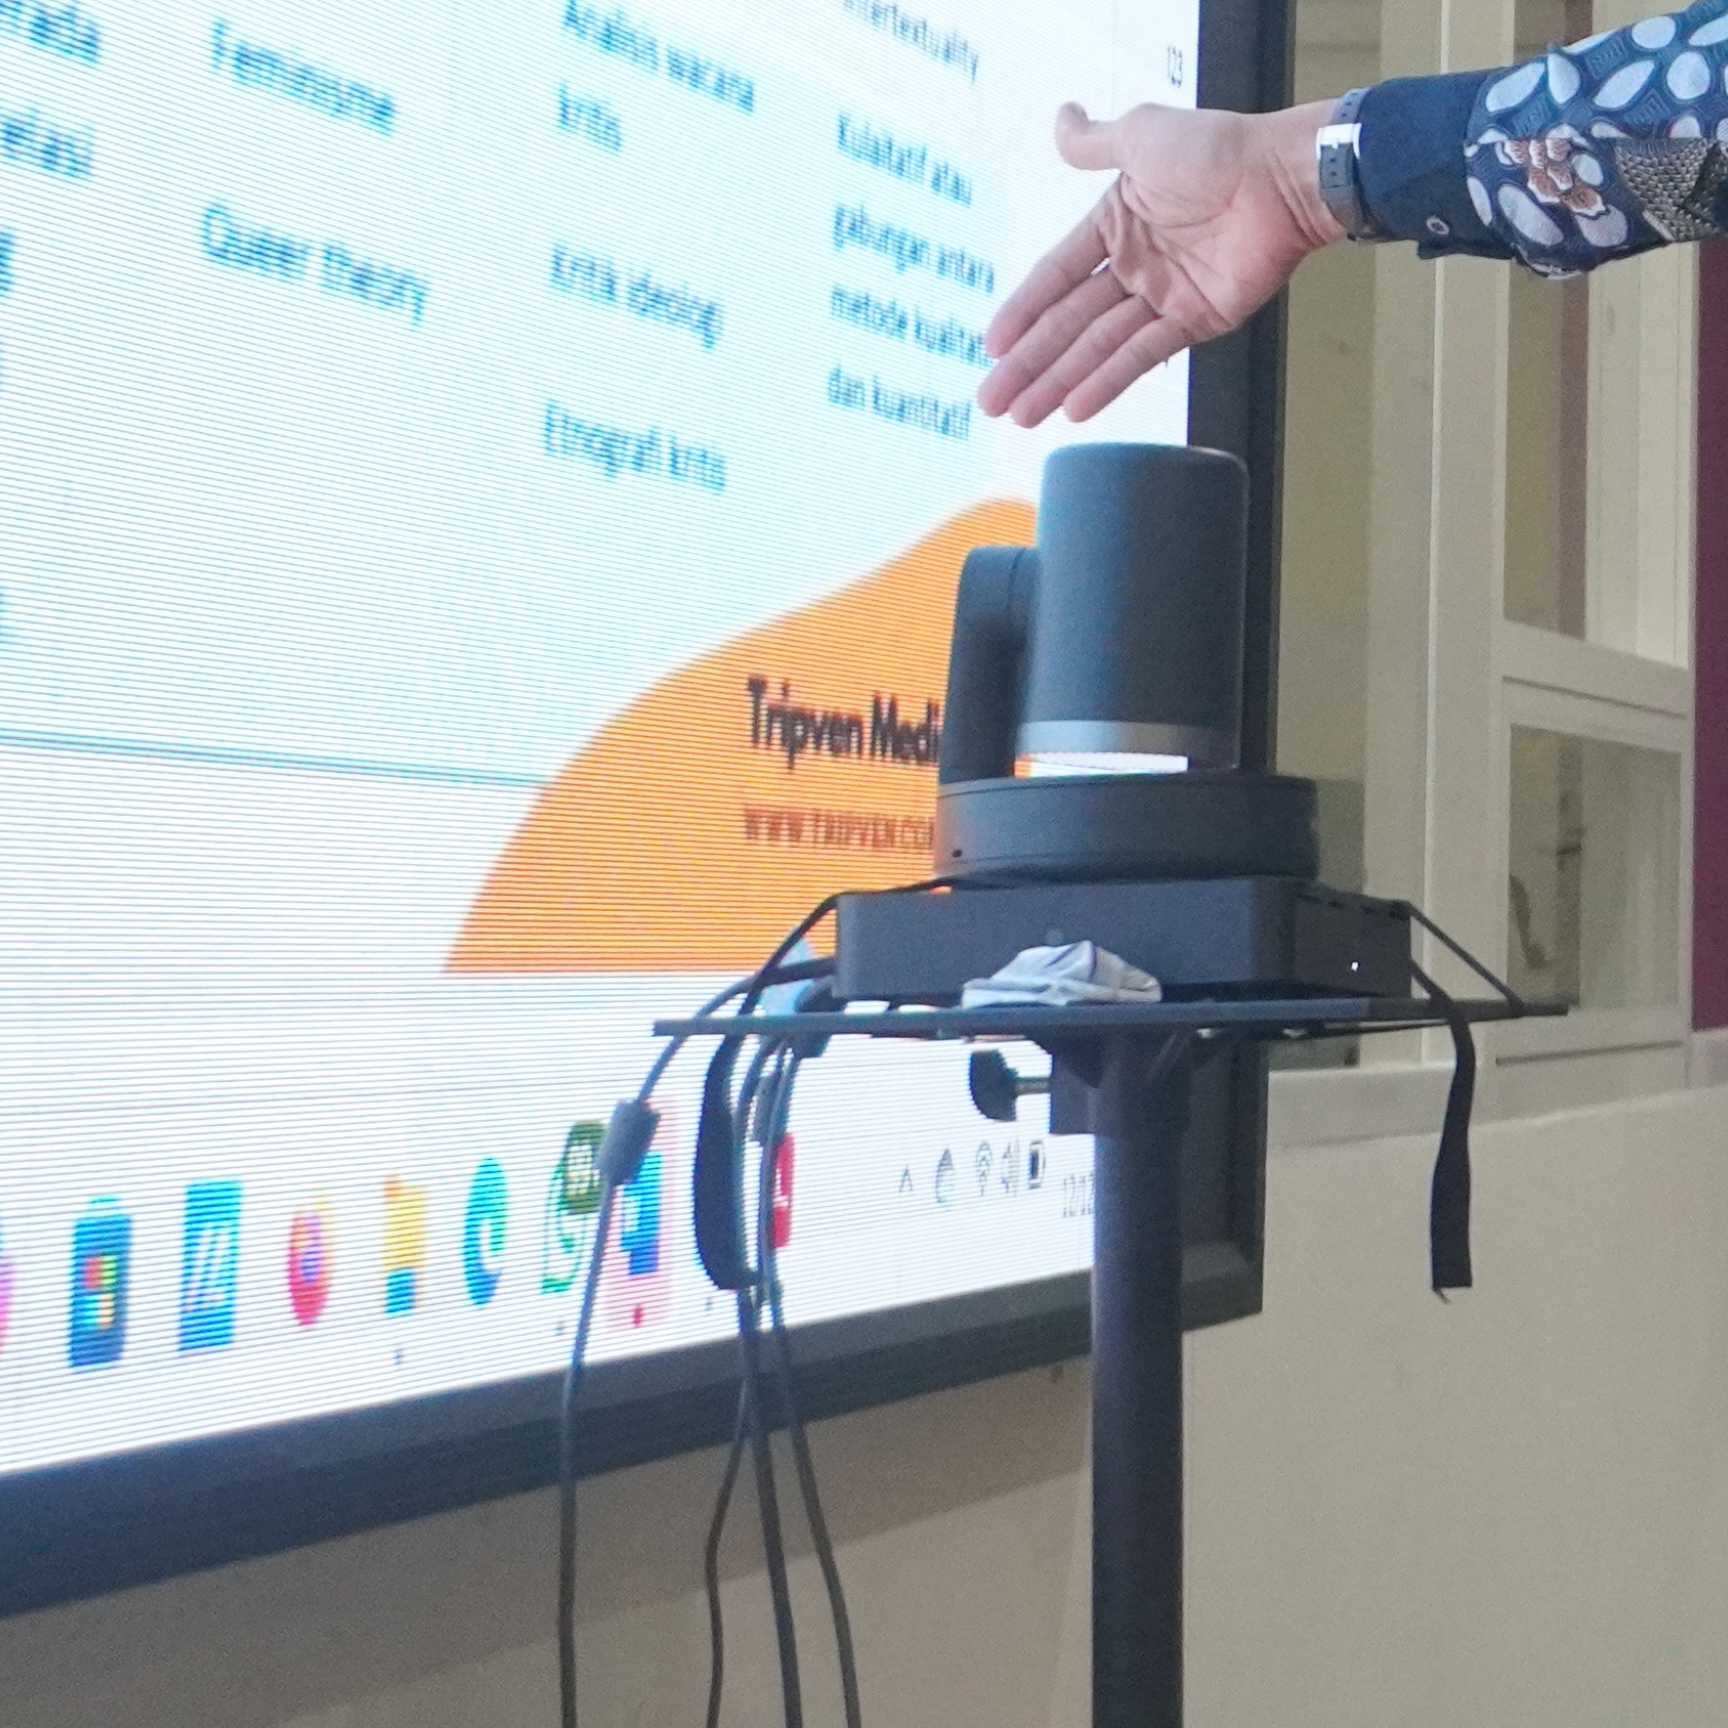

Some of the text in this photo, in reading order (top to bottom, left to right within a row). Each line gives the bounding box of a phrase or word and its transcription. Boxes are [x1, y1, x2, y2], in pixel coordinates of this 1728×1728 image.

[211, 19, 395, 135] Feminisme
[557, 83, 622, 152] kritis
[666, 47, 754, 114] wacana
[836, 114, 971, 205] Kulaitatif atau
[200, 203, 427, 325] Queer theory
[832, 204, 994, 294] gabungan antara
[550, 244, 722, 350] Kritik ideologi
[830, 286, 993, 367] metode kualitat
[543, 401, 726, 492] Etnografi kritis
[826, 365, 971, 438] dan kuantitatif
[748, 674, 864, 771] Tripven
